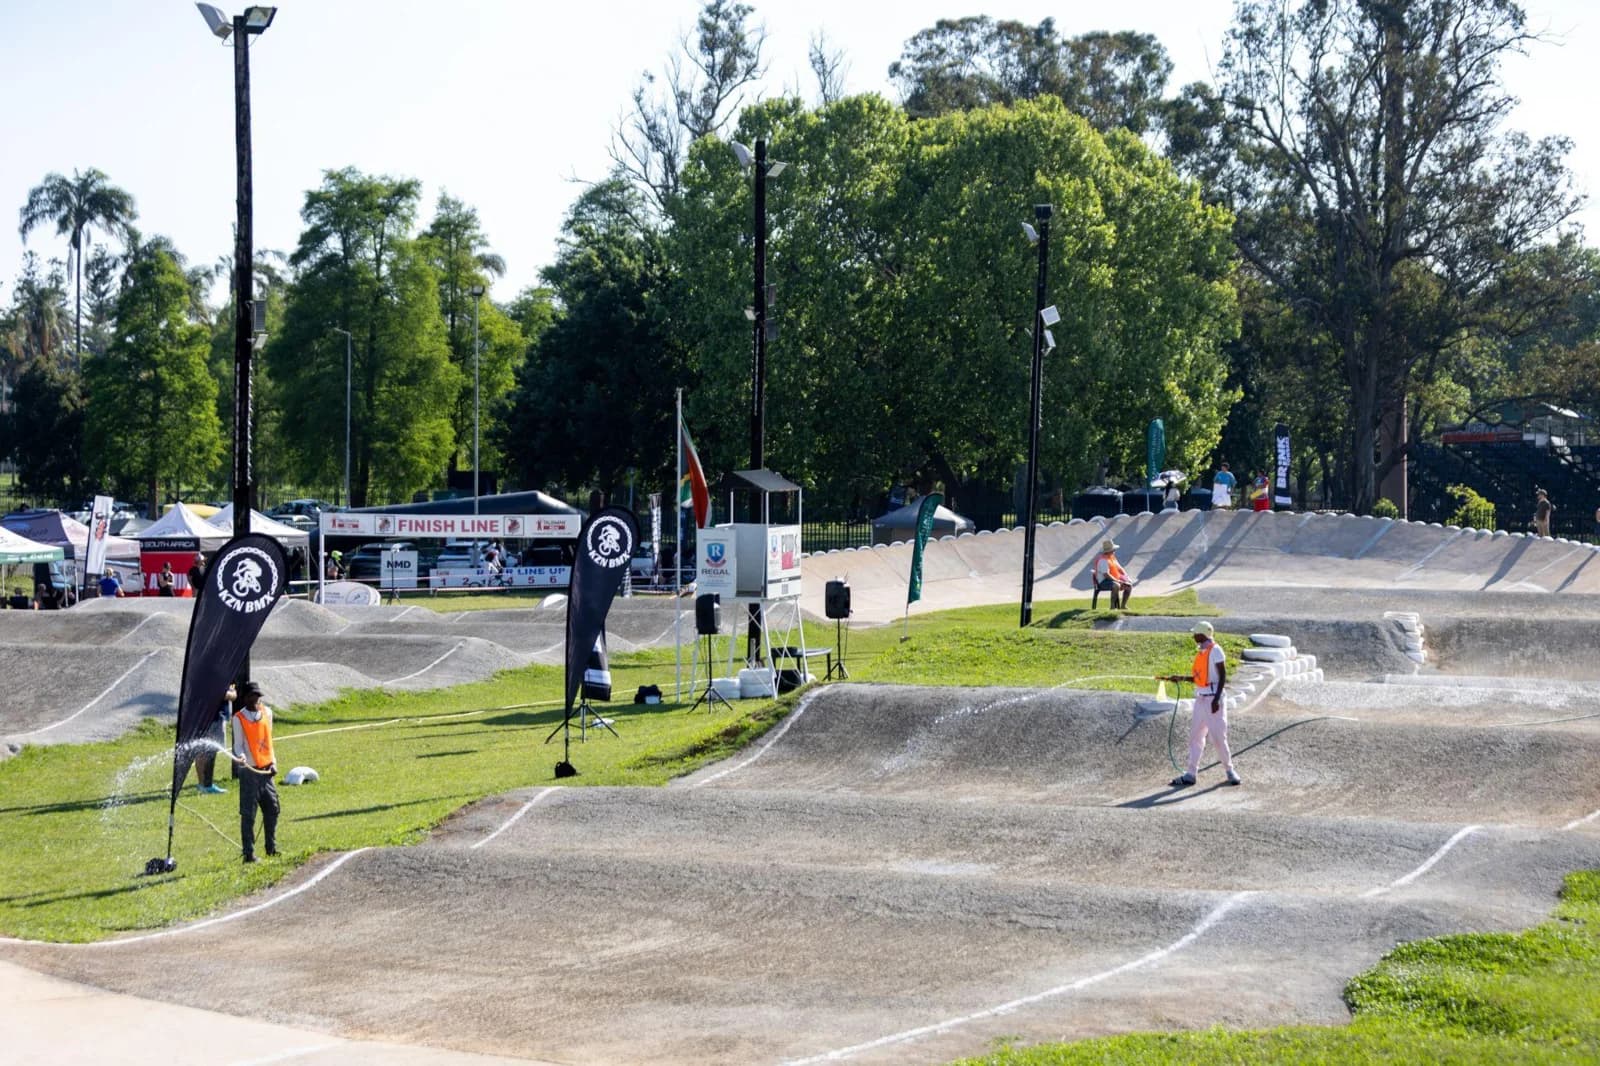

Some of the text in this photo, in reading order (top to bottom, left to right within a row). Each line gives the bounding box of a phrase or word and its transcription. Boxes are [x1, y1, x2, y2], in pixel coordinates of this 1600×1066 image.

[398, 519, 499, 533] FINISH LINE
[387, 560, 411, 569] NMD
[588, 549, 631, 568] KZN BMX
[517, 567, 545, 575] LINE
[550, 567, 566, 575] UP
[218, 589, 275, 613] KZN BMX
